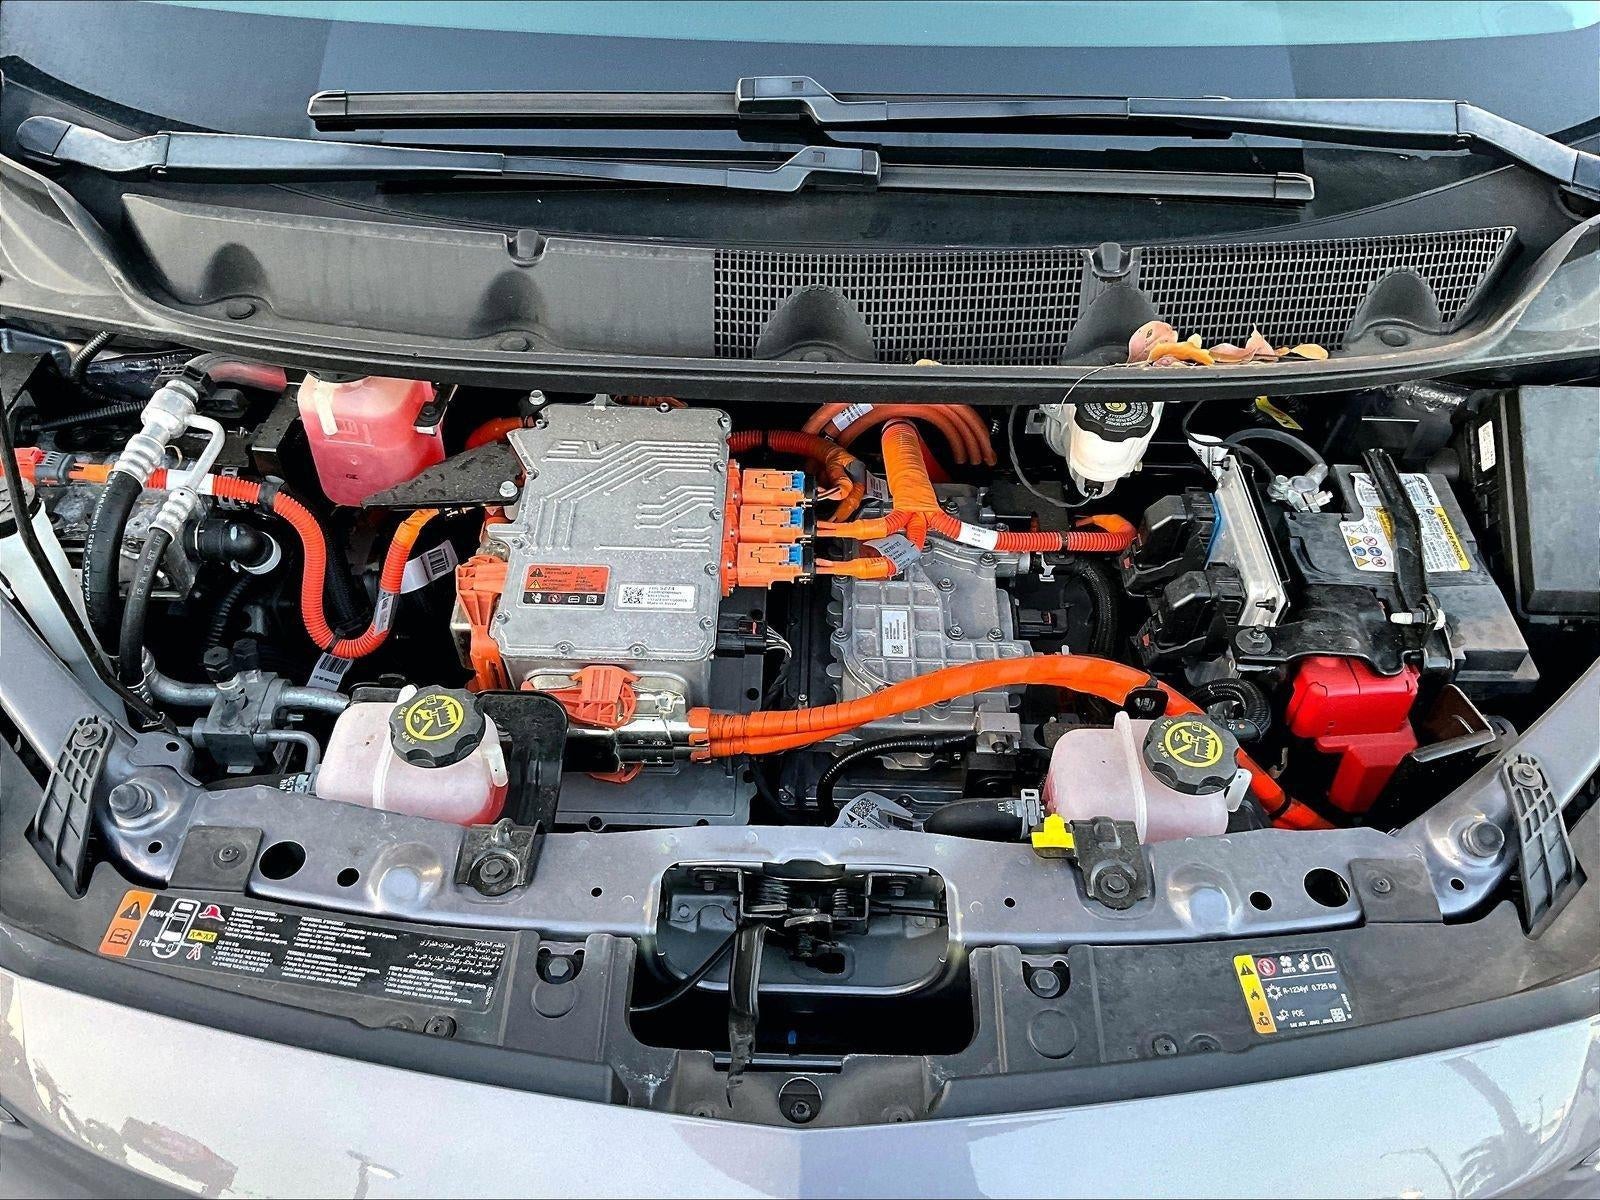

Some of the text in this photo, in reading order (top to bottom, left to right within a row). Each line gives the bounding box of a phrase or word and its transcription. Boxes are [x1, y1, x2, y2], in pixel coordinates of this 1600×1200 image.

[998, 802, 1005, 812] LH
[149, 909, 166, 918] 400V
[139, 939, 151, 948] 12V
[1292, 1009, 1305, 1017] POE
